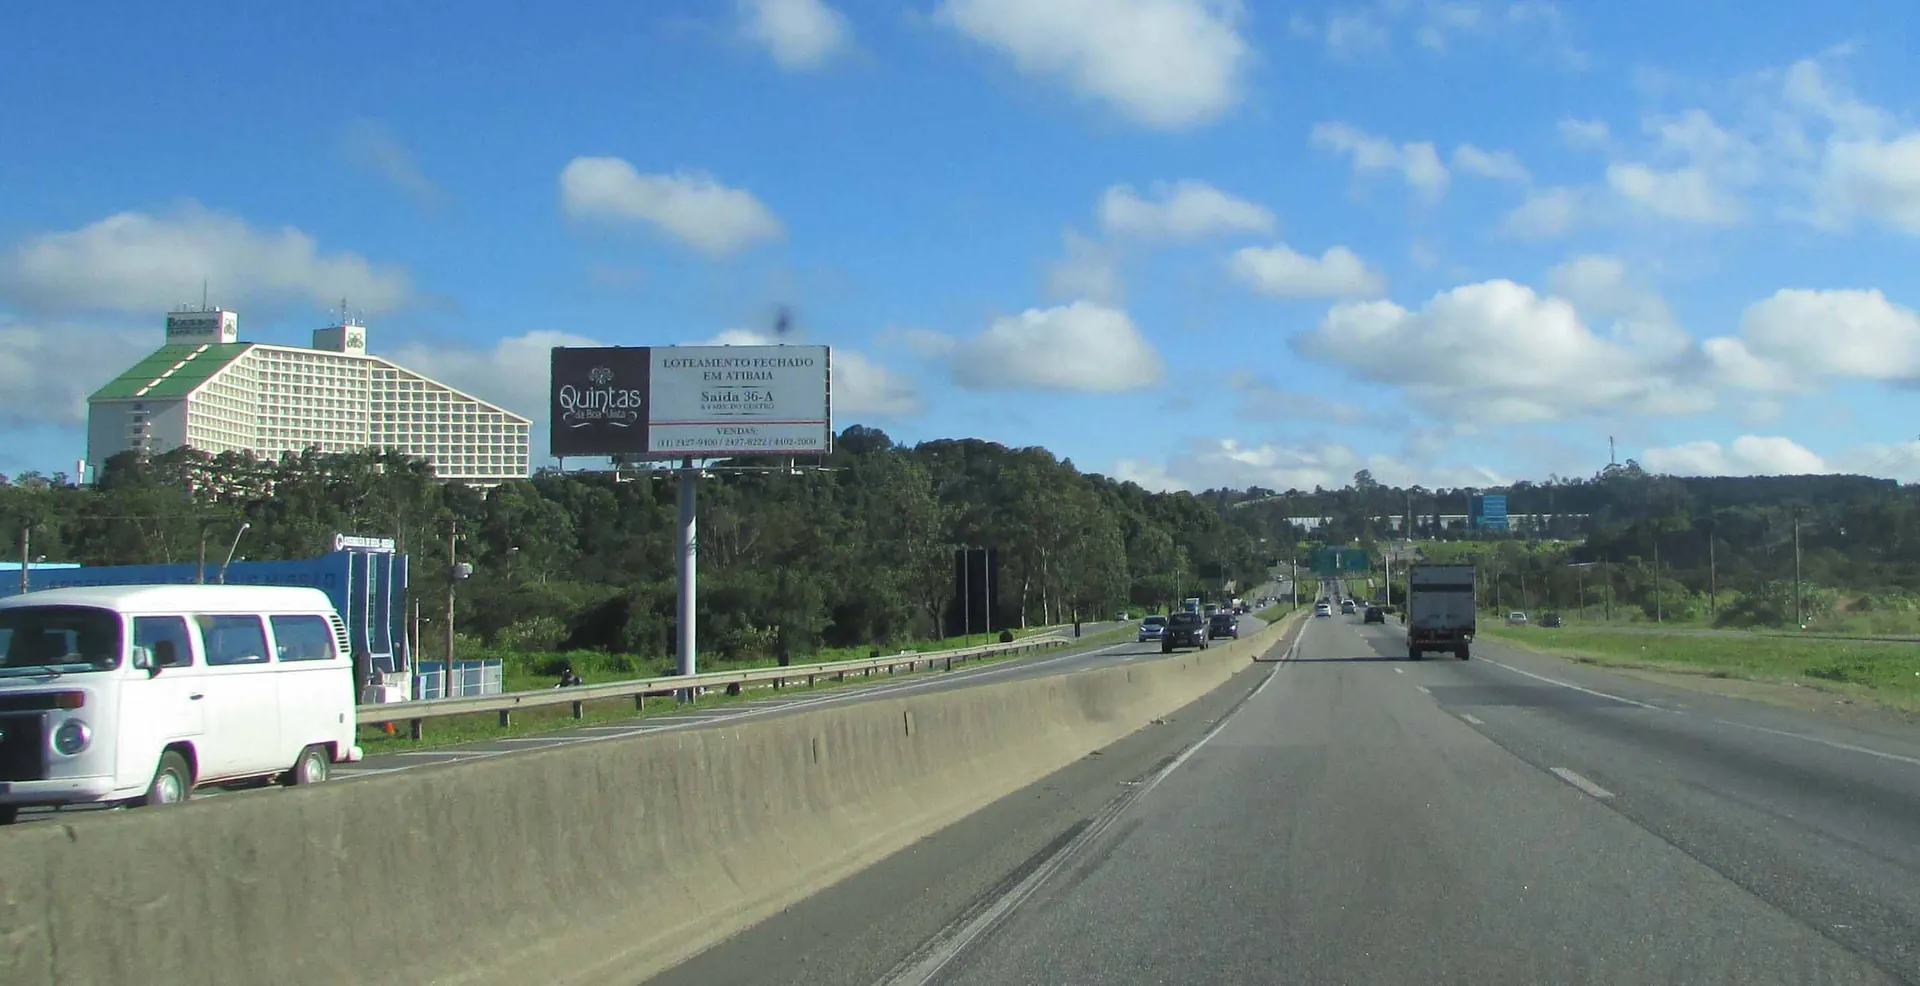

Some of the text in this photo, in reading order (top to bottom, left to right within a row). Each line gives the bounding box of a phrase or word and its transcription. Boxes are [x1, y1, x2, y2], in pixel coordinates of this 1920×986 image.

[663, 357, 814, 368] LOTEAMENTO FECHADO
[704, 371, 774, 381] EM ATIBAIA
[560, 384, 642, 413] Quintas
[744, 391, 774, 402] 36-A
[586, 409, 602, 419] Boa
[716, 427, 759, 435] VENDAS:
